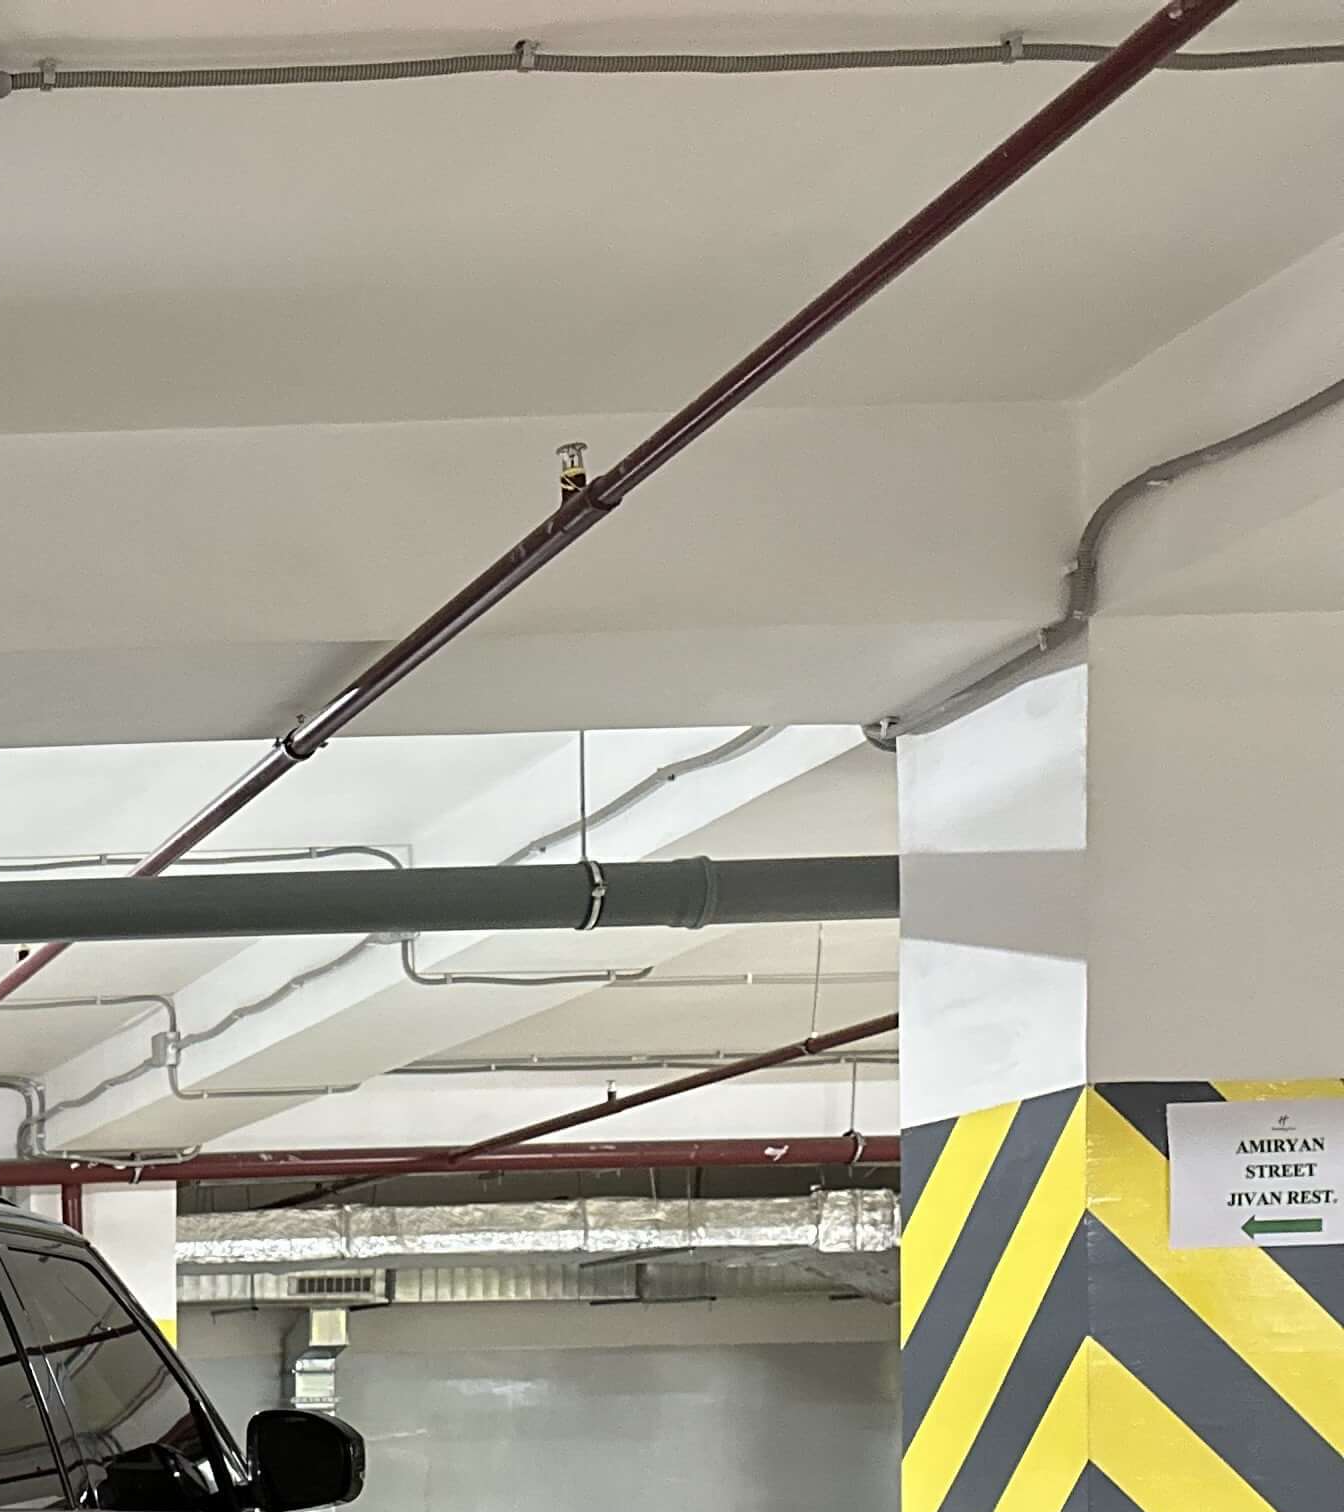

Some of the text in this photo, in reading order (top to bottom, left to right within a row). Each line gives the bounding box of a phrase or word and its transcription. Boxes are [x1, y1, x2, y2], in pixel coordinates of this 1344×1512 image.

[1236, 1136, 1325, 1155] AMIRYAN
[1245, 1163, 1317, 1179] STREET
[1227, 1189, 1338, 1207] JIVAN REST.
